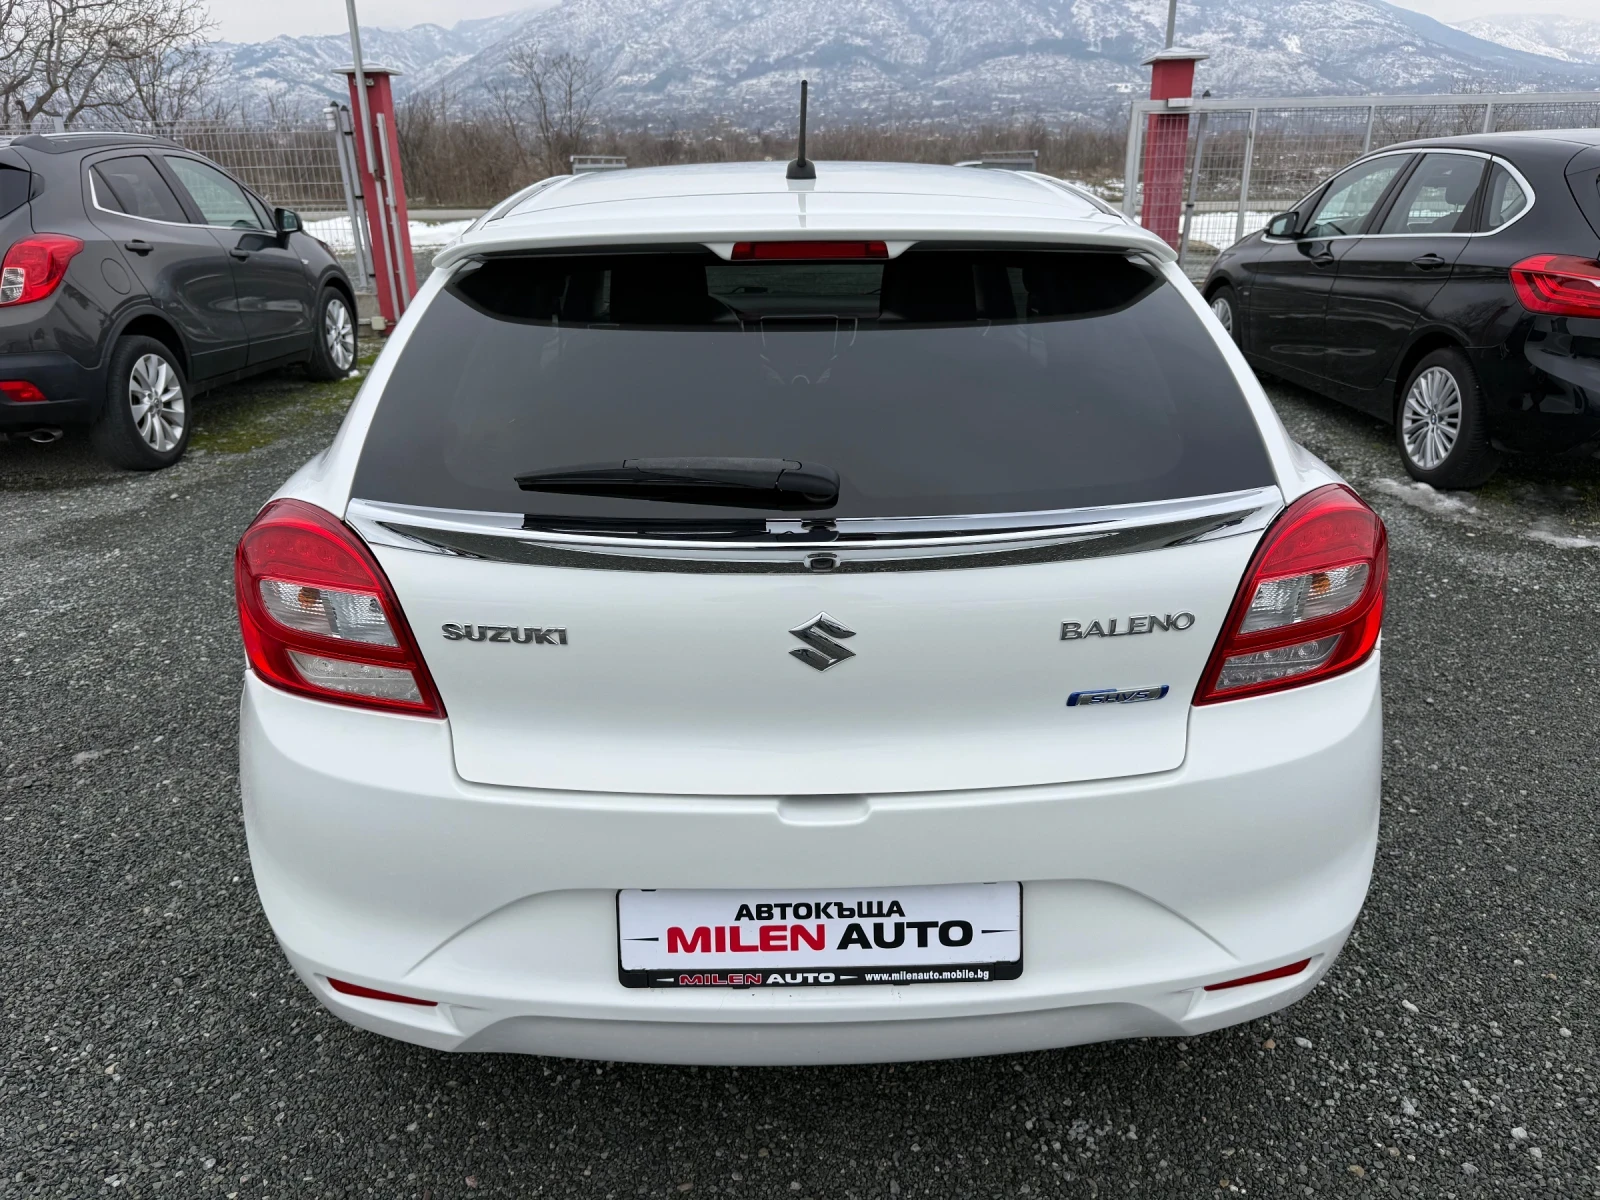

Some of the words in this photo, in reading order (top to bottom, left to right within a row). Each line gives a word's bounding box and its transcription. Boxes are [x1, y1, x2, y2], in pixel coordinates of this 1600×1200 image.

[441, 622, 568, 645] SUZUKI
[1060, 610, 1195, 640] BALENO
[667, 924, 825, 953] MILEN
[836, 921, 973, 950] AUTO
[679, 973, 762, 985] MILEN
[766, 972, 835, 984] AUTO
[864, 969, 990, 981] www.milenauto.mobile.bg
